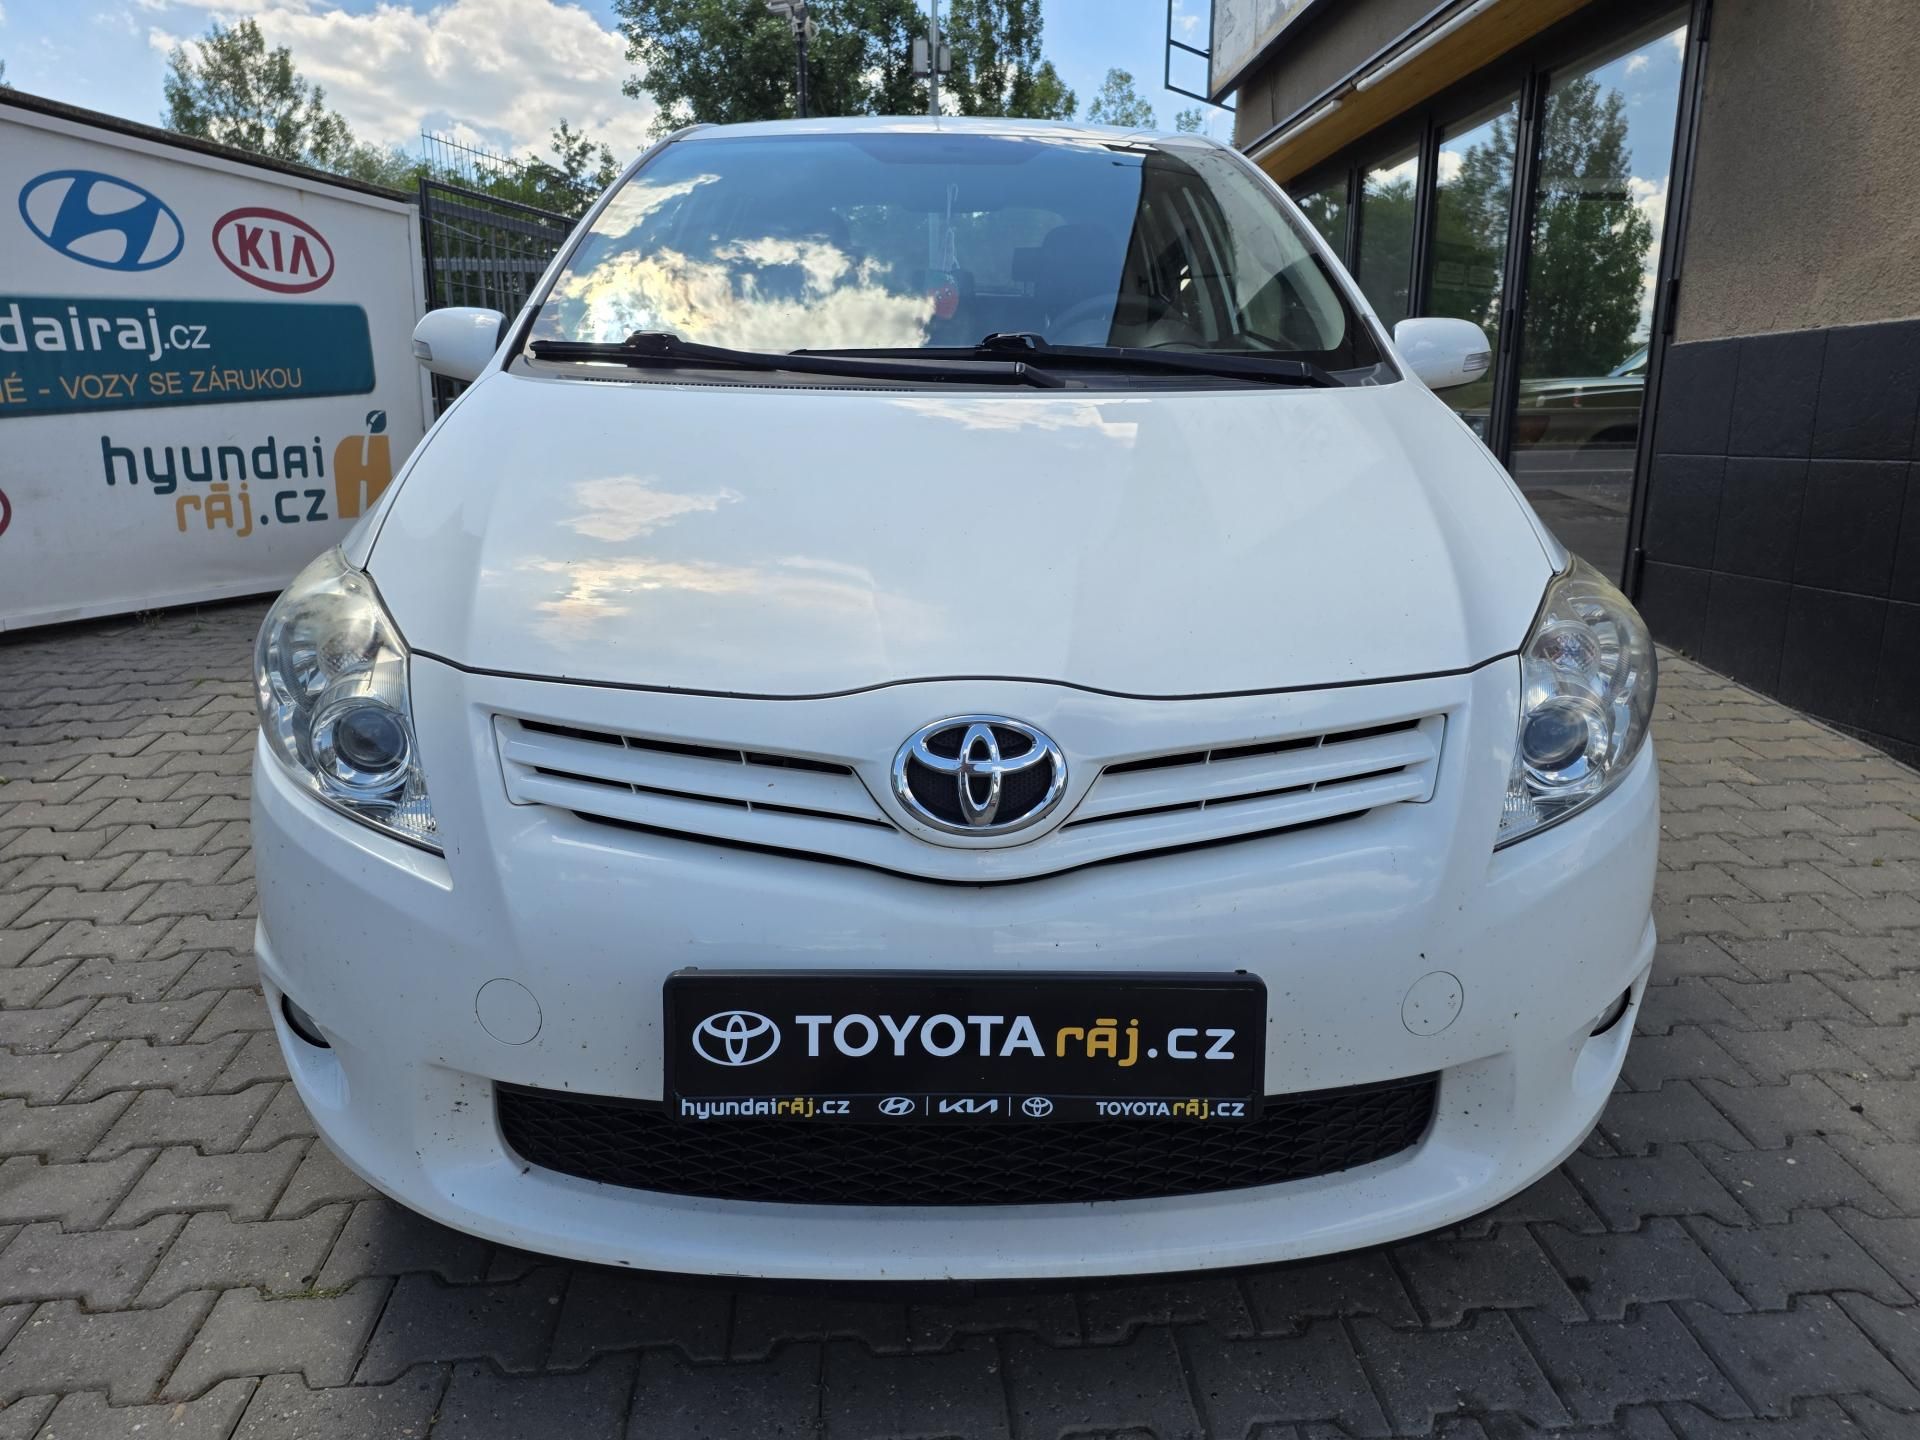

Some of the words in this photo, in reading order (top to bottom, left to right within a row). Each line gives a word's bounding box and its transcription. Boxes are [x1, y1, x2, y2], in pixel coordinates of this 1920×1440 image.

[235, 223, 318, 278] KIA
[60, 372, 138, 400] VOZY
[149, 369, 183, 395] SE
[191, 365, 302, 393] ZÁRUKOU
[795, 1013, 1046, 1057] TOYOTA
